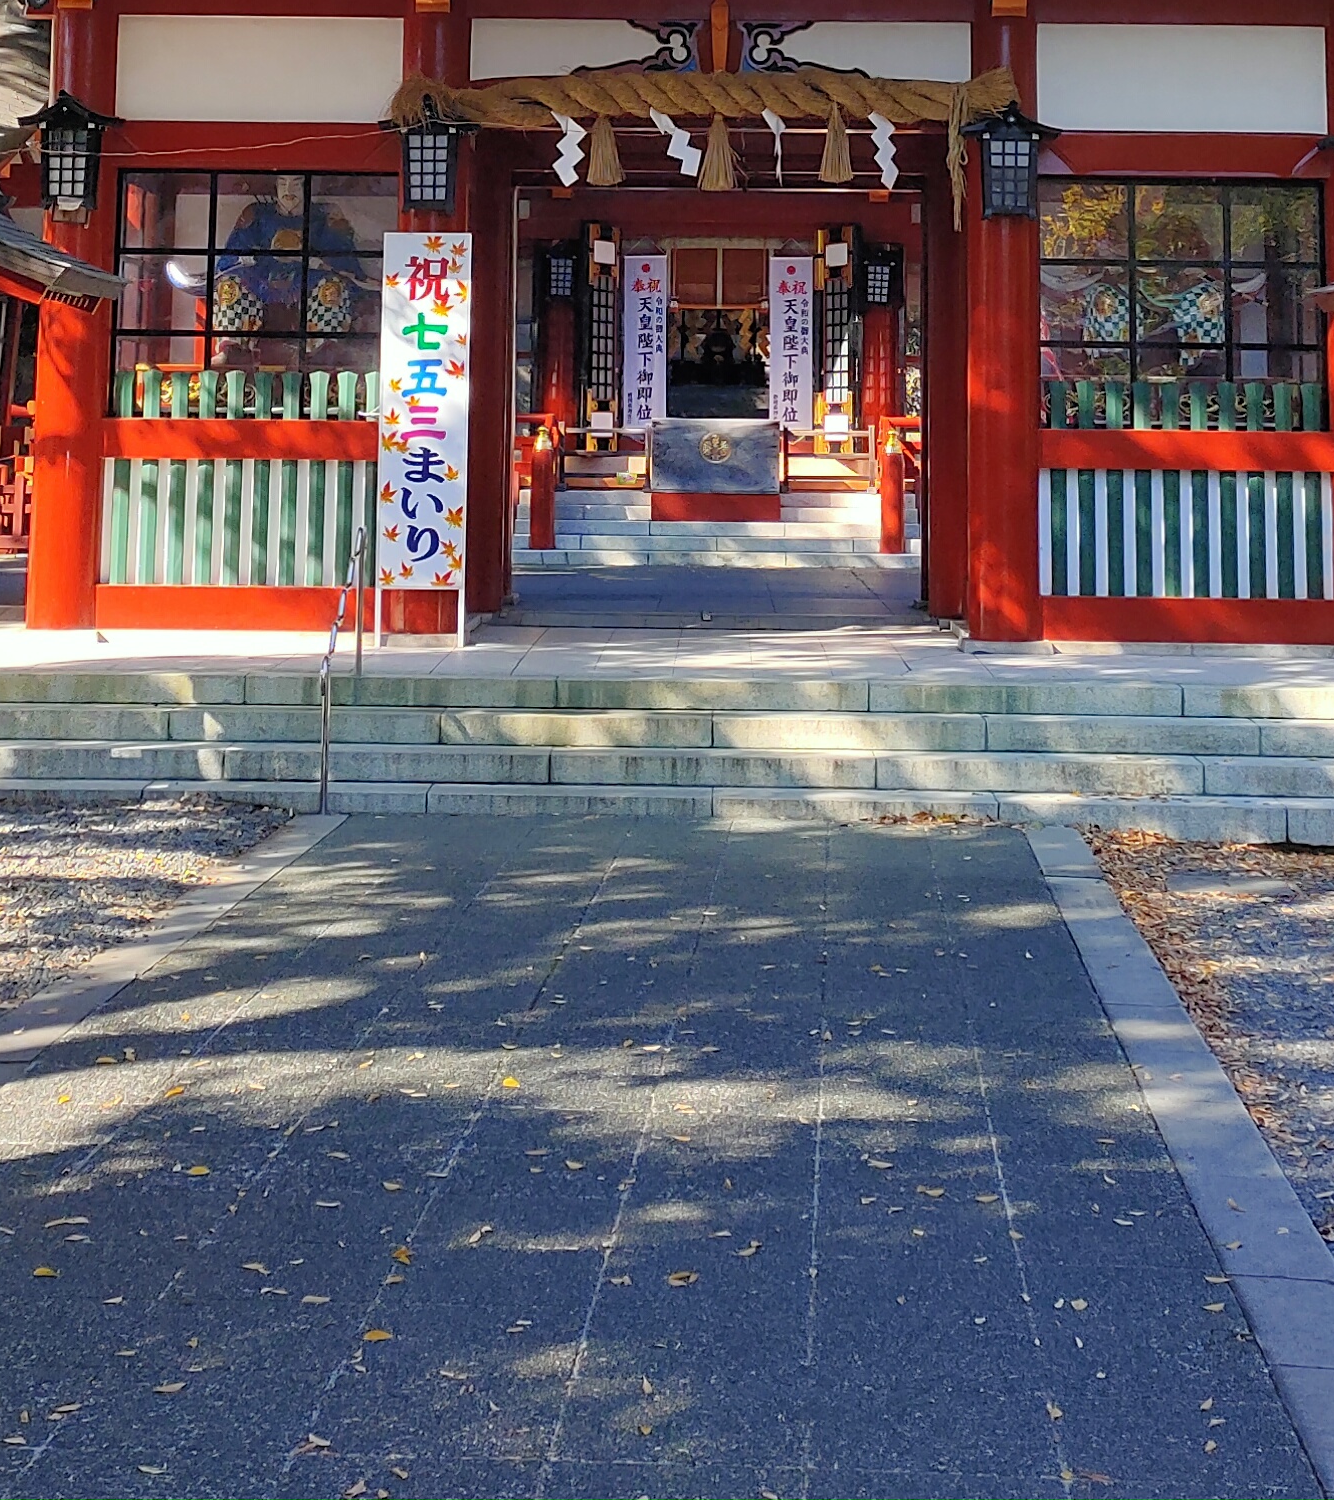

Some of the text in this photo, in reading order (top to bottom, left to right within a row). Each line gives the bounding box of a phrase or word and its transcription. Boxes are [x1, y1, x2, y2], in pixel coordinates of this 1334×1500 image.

[631, 277, 662, 293] 奉祝
[776, 280, 808, 296] 奉祝
[400, 255, 450, 563] 祝七五三まいり
[636, 296, 654, 421] 天皇陛下御即位
[781, 298, 801, 423] 天皇陛下御即位
